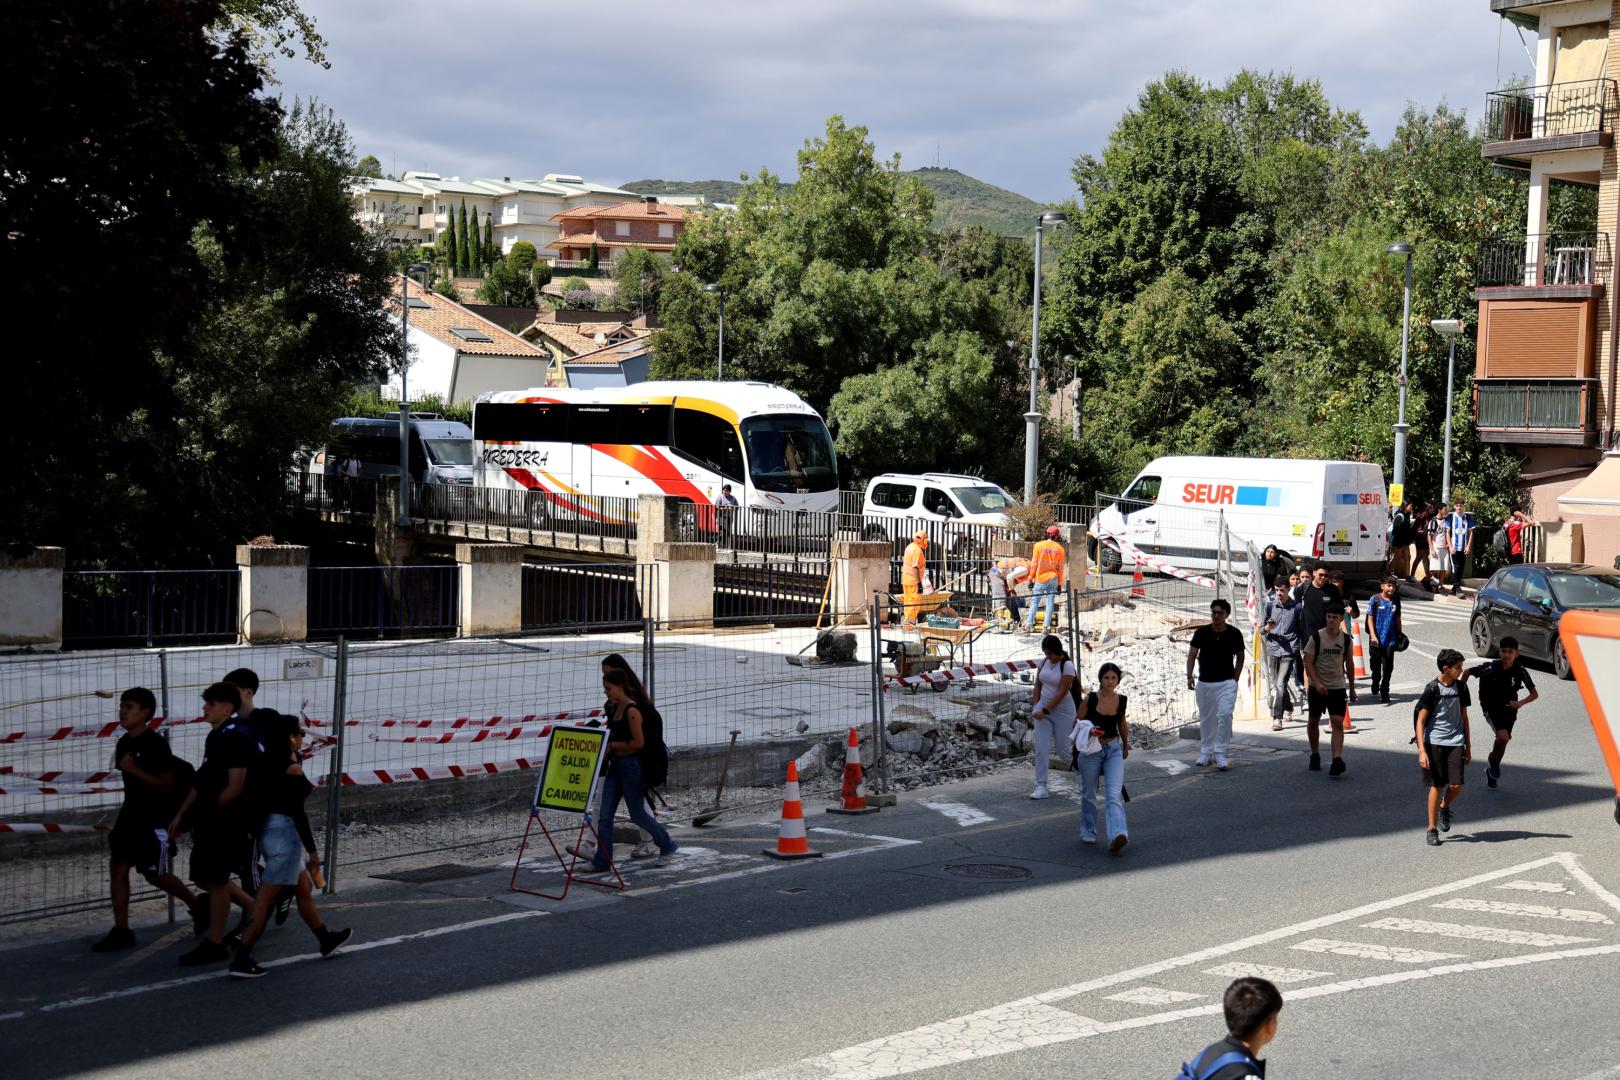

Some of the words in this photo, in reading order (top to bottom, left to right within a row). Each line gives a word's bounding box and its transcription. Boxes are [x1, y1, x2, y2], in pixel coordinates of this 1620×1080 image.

[483, 449, 549, 466] UREDERRA
[1182, 483, 1235, 505] SEUR
[1359, 493, 1381, 505] SEUR
[560, 755, 591, 768] SALIDA
[568, 773, 581, 784] DE
